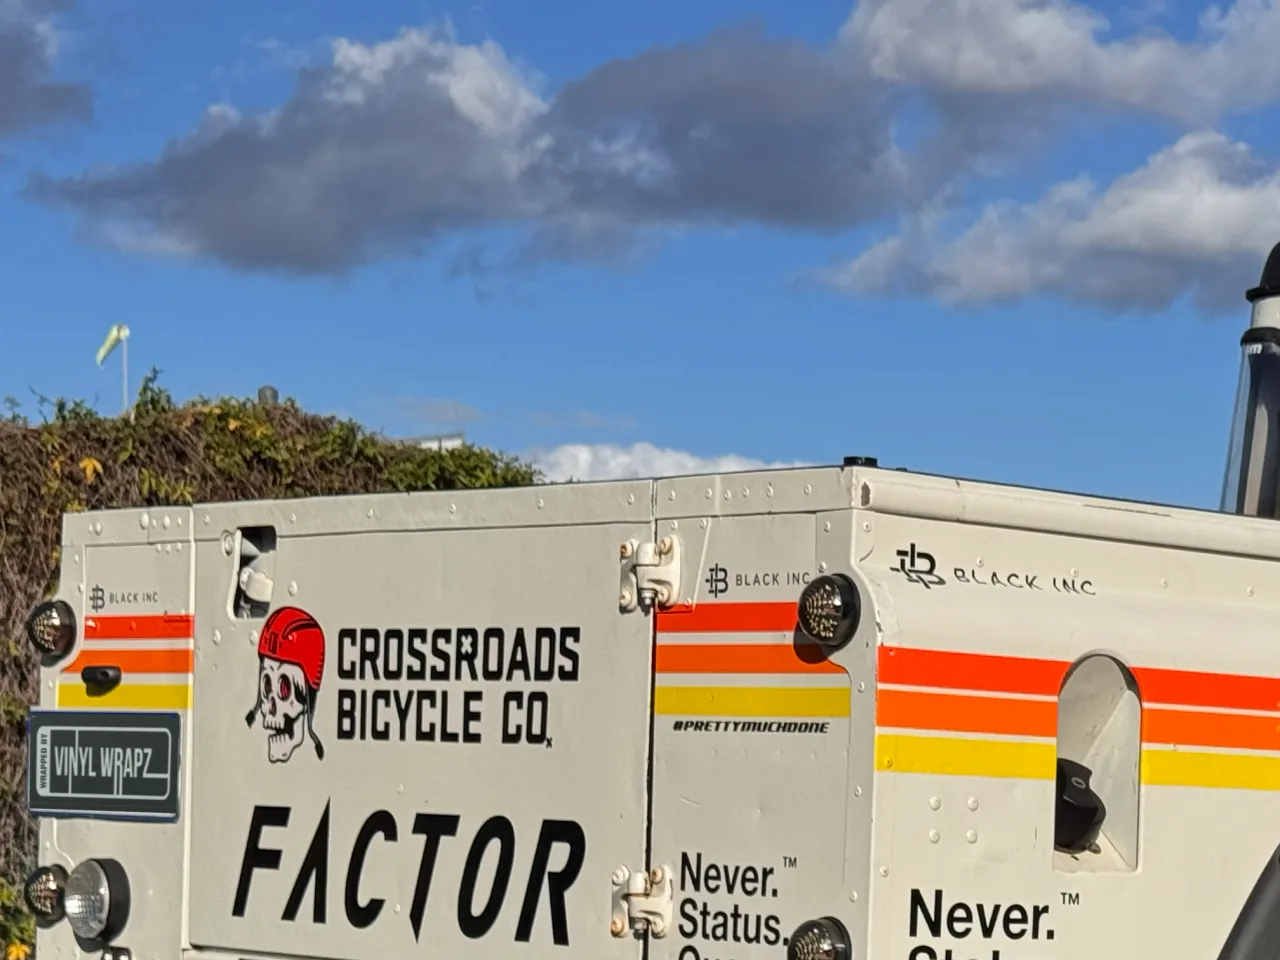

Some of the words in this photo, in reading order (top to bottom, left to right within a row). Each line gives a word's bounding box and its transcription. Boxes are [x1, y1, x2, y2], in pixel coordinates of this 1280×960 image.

[109, 591, 139, 605] BLACK
[142, 591, 159, 603] INC
[735, 573, 780, 587] BLACK
[786, 572, 811, 585] INC
[953, 567, 1043, 591] BLACK
[1052, 576, 1097, 596] INC
[337, 626, 581, 682] CROSSROADS
[39, 733, 48, 745] BY
[336, 689, 483, 744] BICYCLE
[673, 720, 831, 734] #PRETTYMUCHDONE
[39, 747, 48, 789] WRAPPED
[54, 741, 97, 783] VINYL
[100, 746, 156, 787] WRAPZ
[231, 795, 587, 947] FACTOR
[679, 851, 779, 898] Never.
[678, 897, 790, 947] Status.
[908, 888, 1055, 940] Never.
